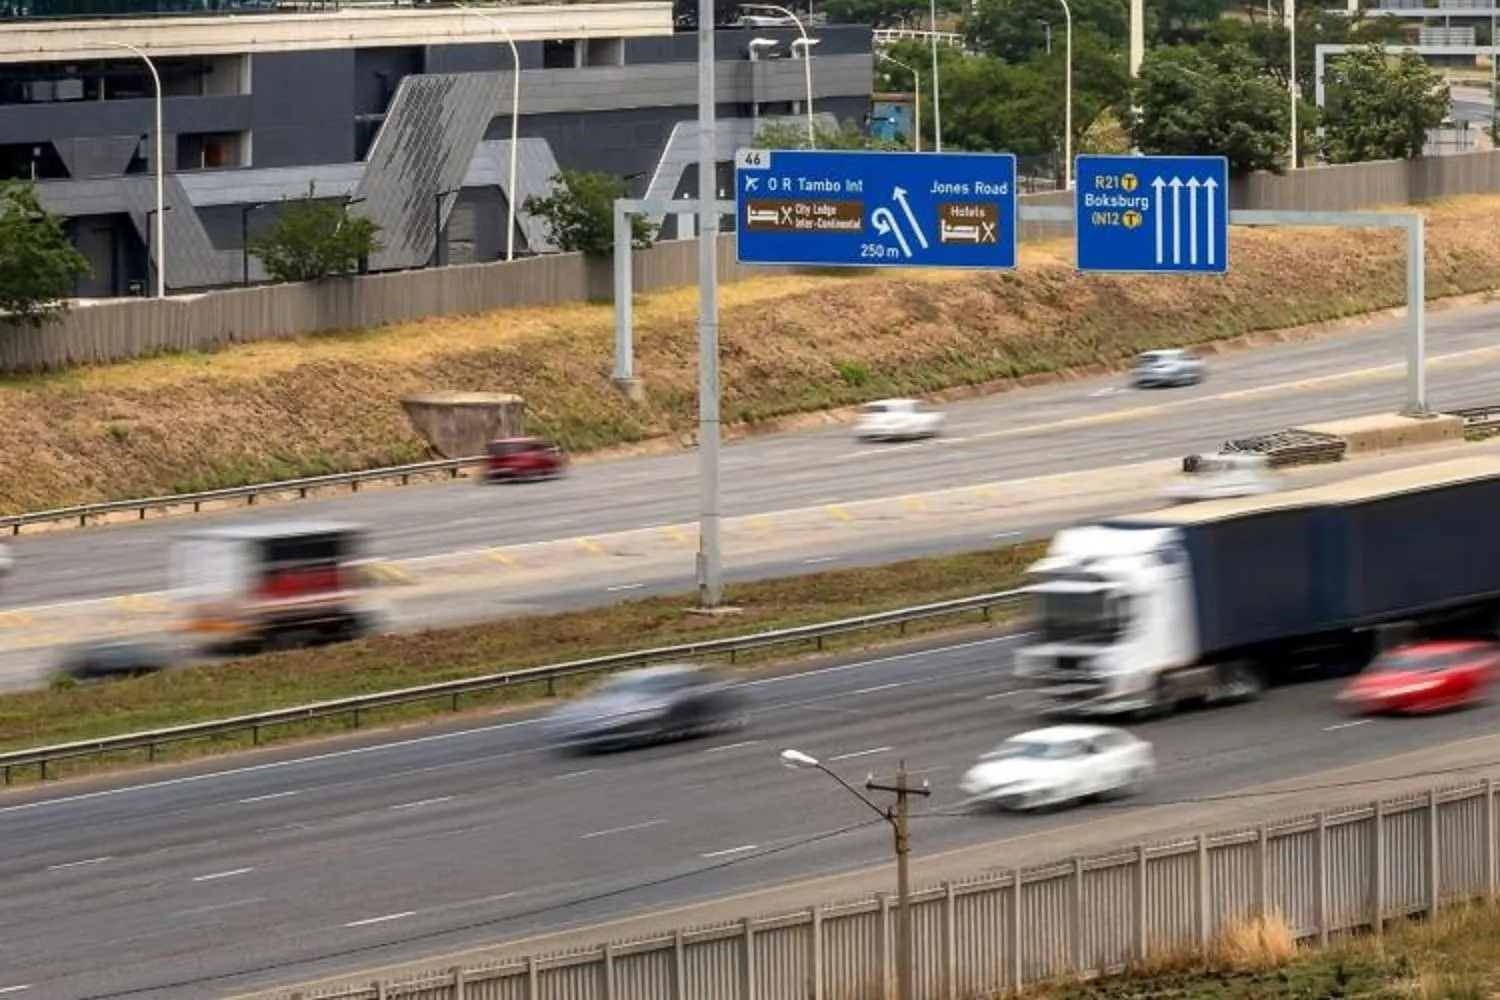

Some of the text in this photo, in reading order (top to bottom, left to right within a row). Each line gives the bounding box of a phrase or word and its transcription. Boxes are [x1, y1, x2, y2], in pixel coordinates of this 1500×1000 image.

[745, 152, 760, 165] 46
[767, 177, 863, 192] O R Tambo Int
[930, 180, 1008, 195] Jones Road
[1095, 175, 1119, 189] R21
[1085, 193, 1149, 211] Boksburg
[951, 206, 986, 217] Hotels
[860, 244, 899, 258] 250 m
